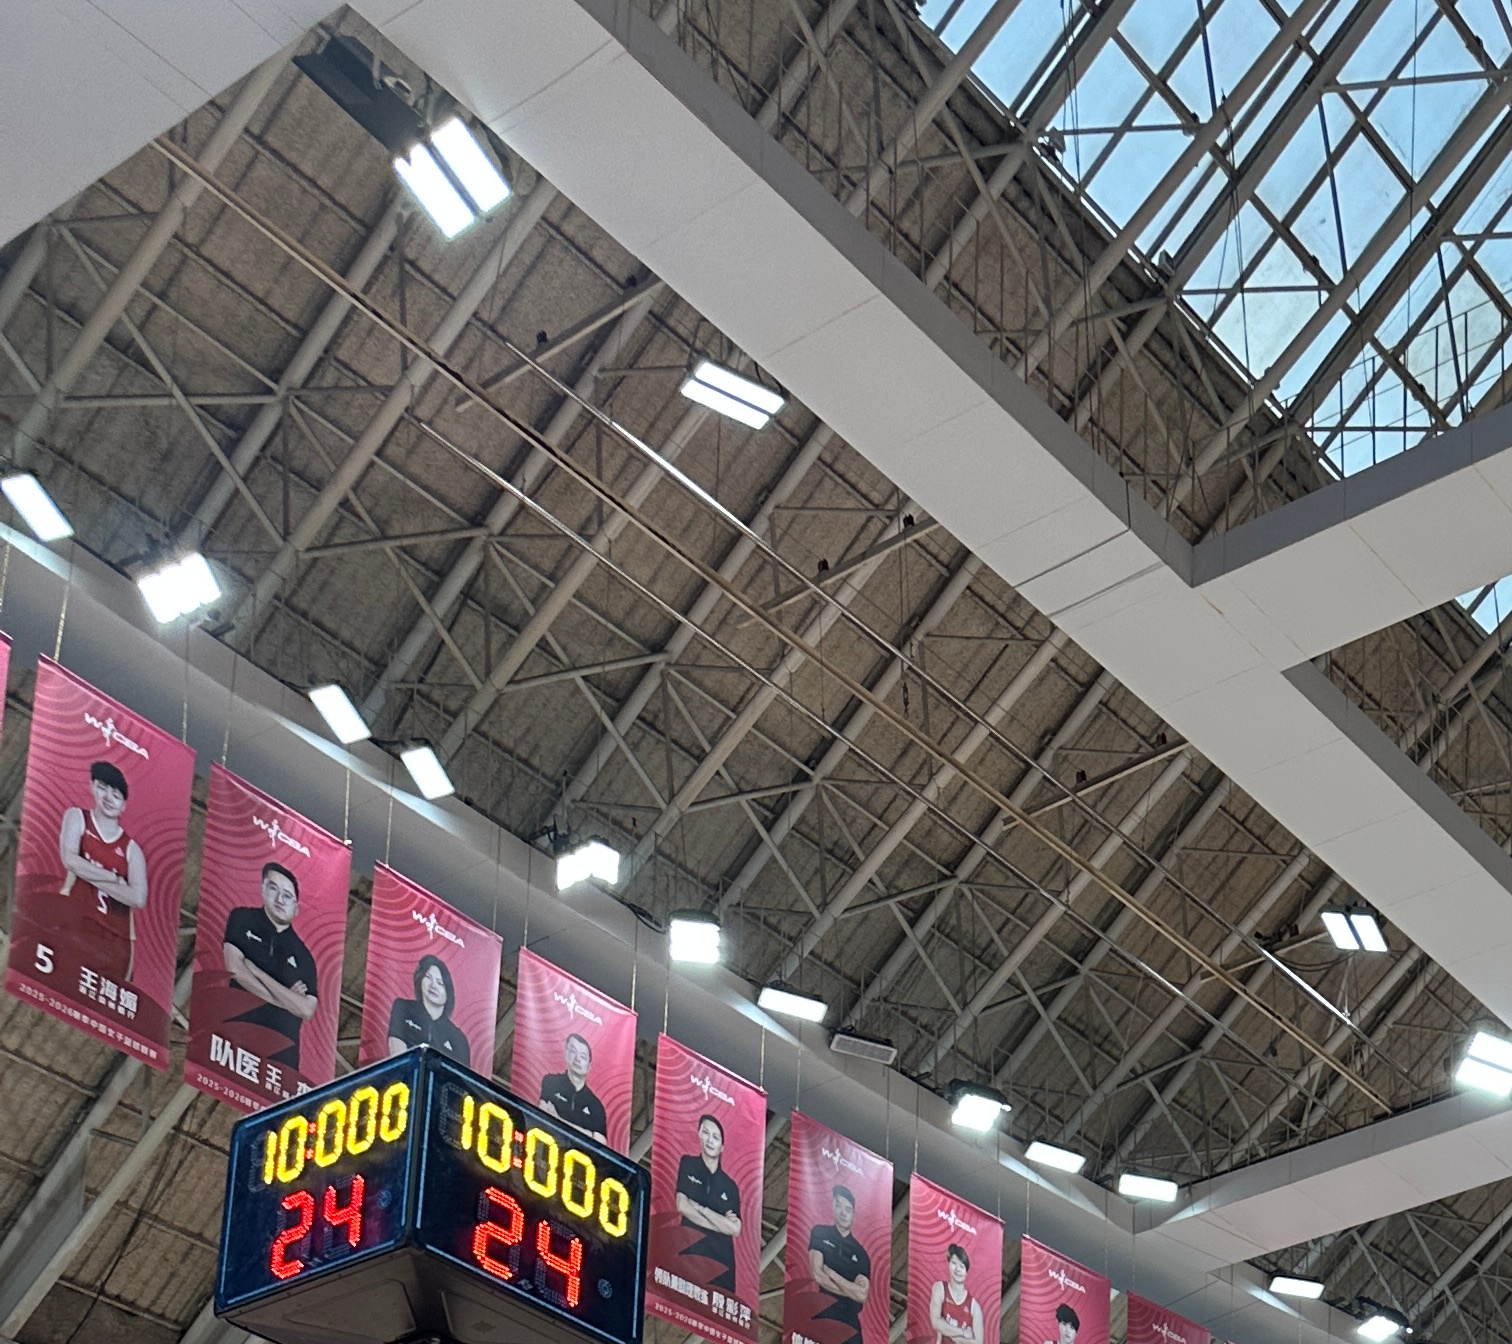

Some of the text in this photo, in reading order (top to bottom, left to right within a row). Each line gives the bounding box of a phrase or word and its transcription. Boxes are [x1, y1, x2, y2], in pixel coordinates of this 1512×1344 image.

[34, 943, 55, 973] 5
[209, 1033, 261, 1084] 队医
[270, 1173, 366, 1280] 24
[472, 1186, 584, 1308] 24
